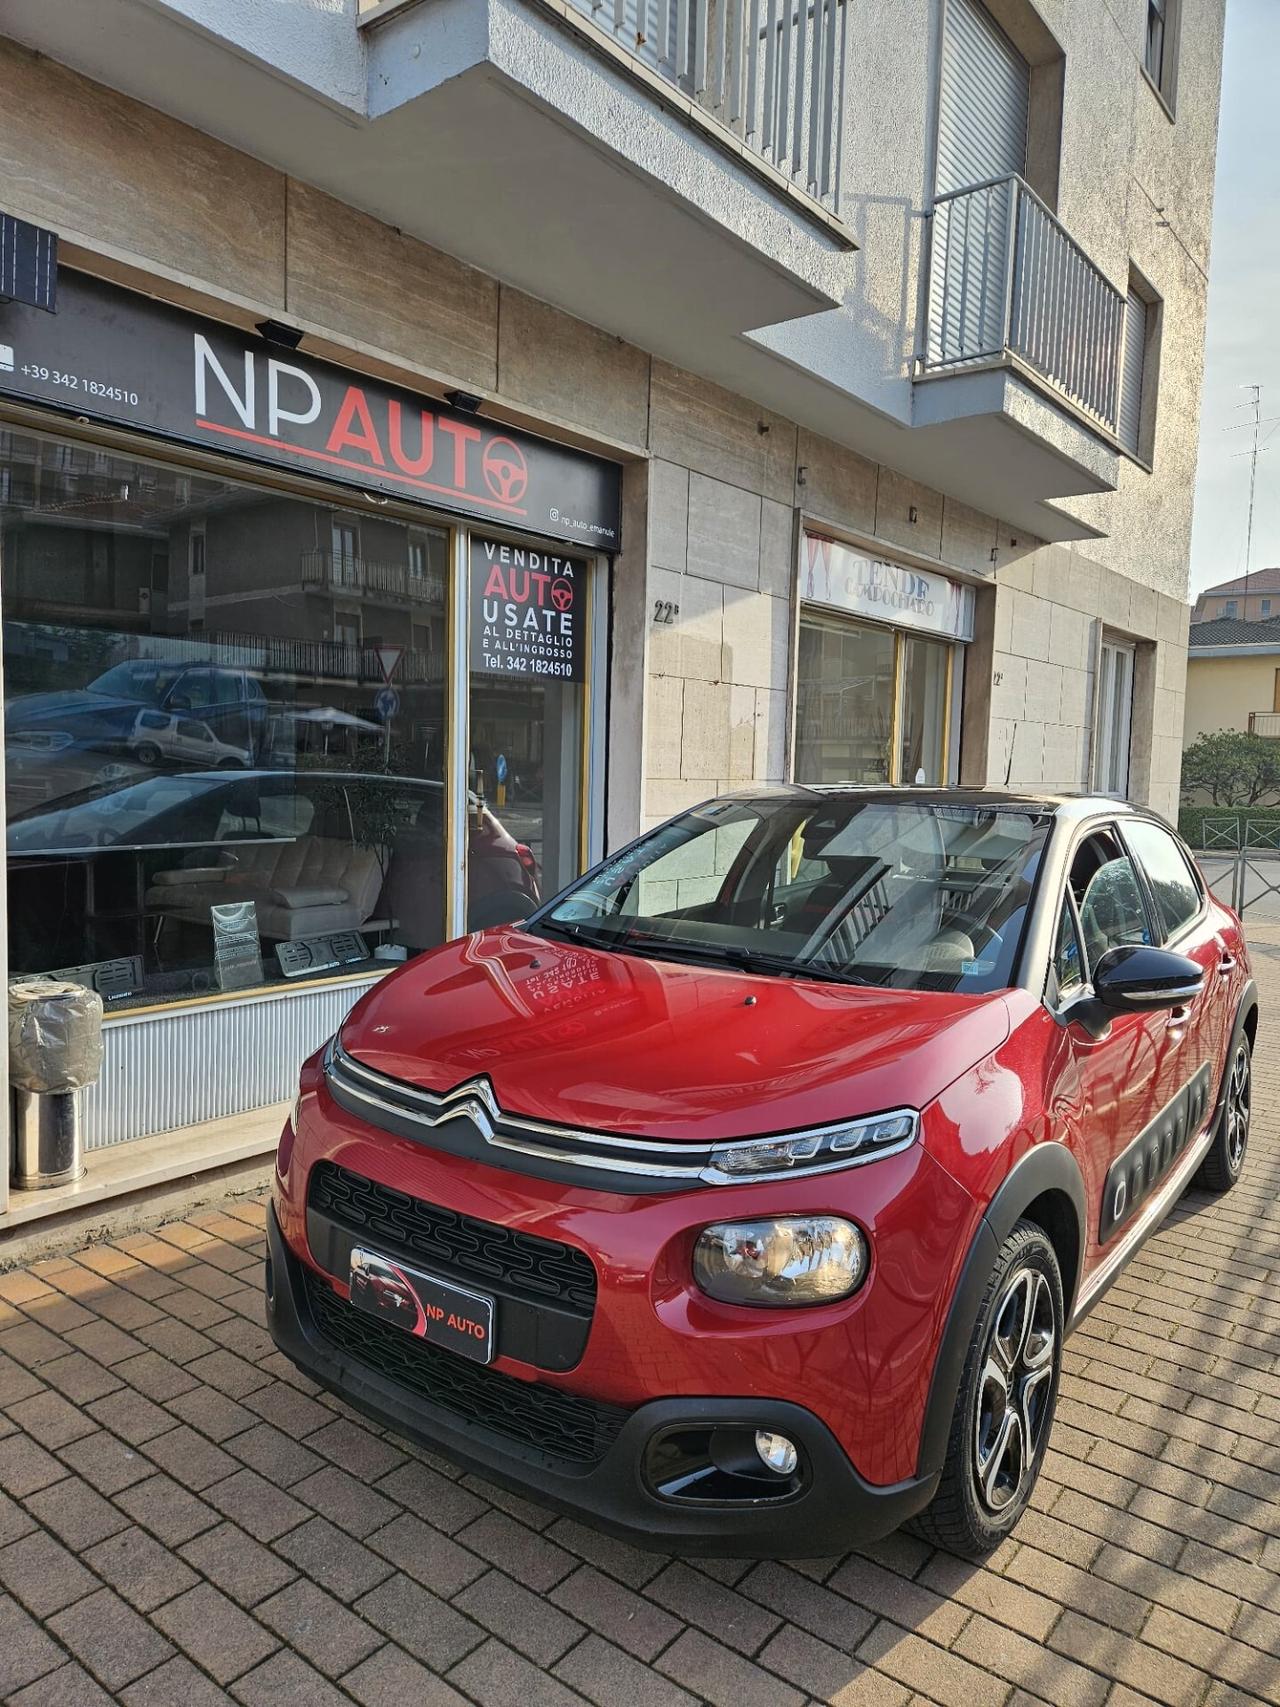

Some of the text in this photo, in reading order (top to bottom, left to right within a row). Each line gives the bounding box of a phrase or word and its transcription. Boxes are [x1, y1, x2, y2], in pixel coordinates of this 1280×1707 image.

[21, 365, 139, 406] +39 342 1824510
[483, 542, 574, 578] VENDITA
[483, 600, 573, 635] USATE
[483, 638, 573, 658] E ALL'INGROSSO
[484, 625, 573, 647] AL DETTAGLIO
[483, 653, 572, 676] Tel. 342 1824510
[426, 1303, 486, 1340] NP AUTO
